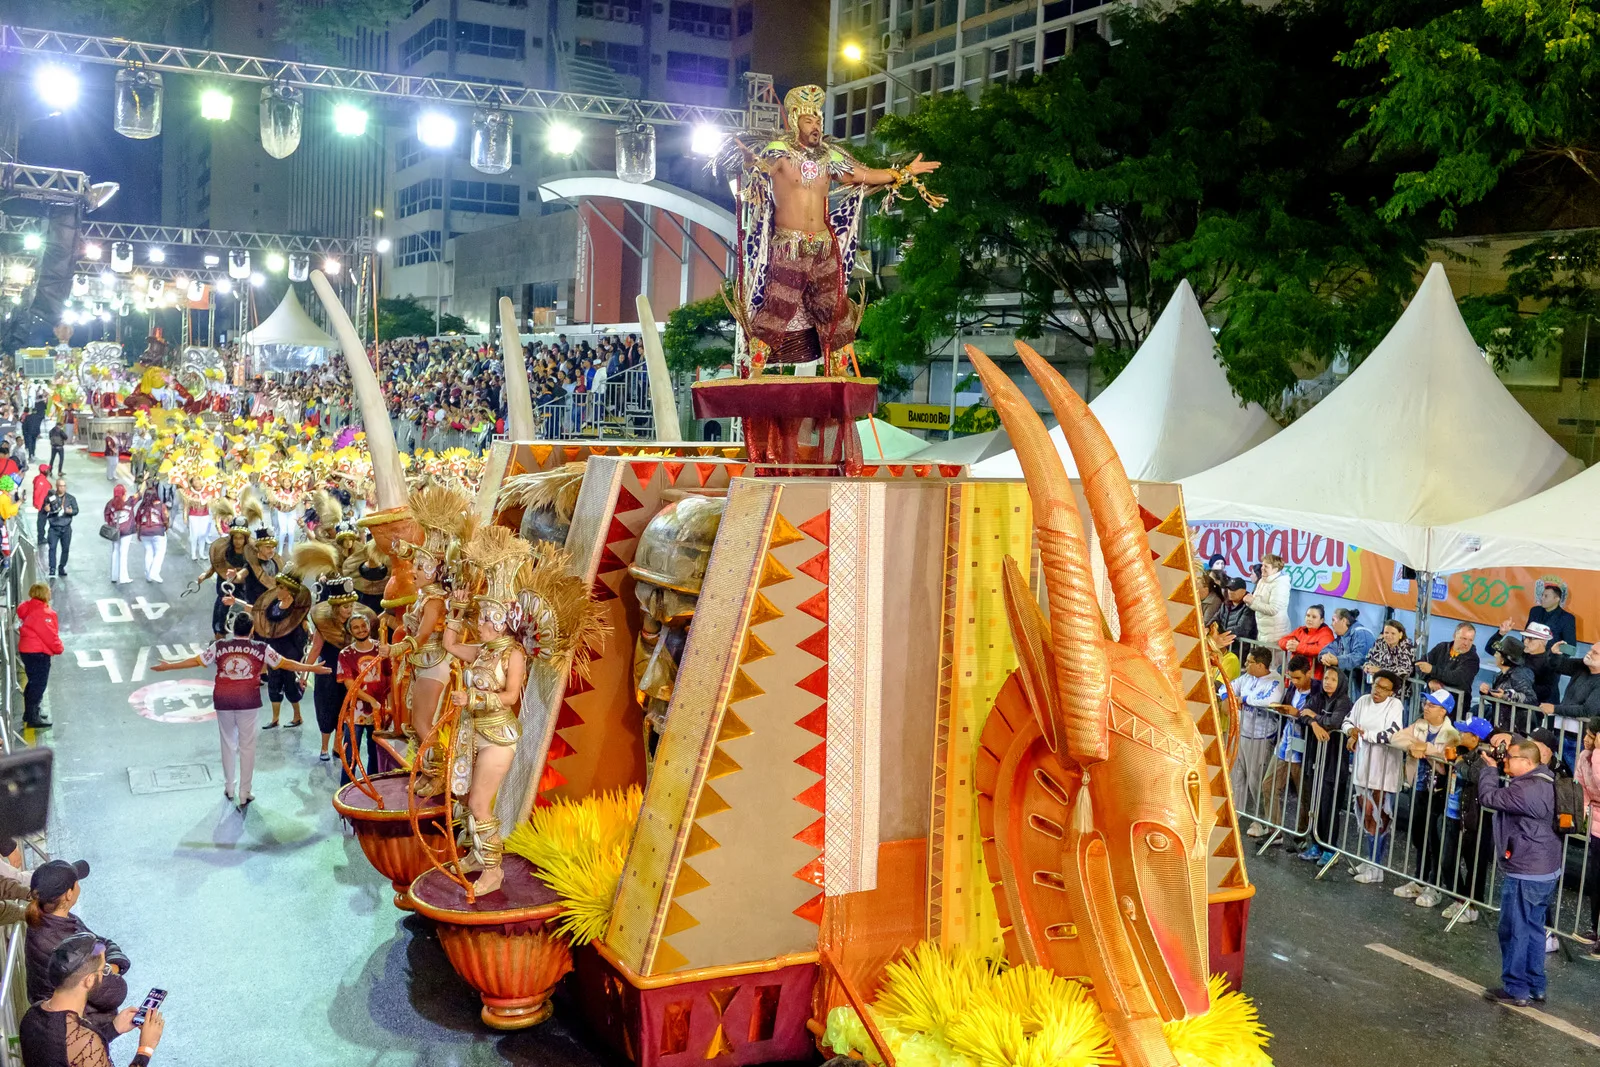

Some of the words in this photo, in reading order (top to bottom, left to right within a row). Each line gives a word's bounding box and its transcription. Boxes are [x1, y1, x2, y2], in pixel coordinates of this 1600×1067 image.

[908, 410, 928, 422] BANCO
[929, 413, 937, 424] DO
[96, 596, 171, 623] 40
[216, 645, 265, 661] HARMONIA
